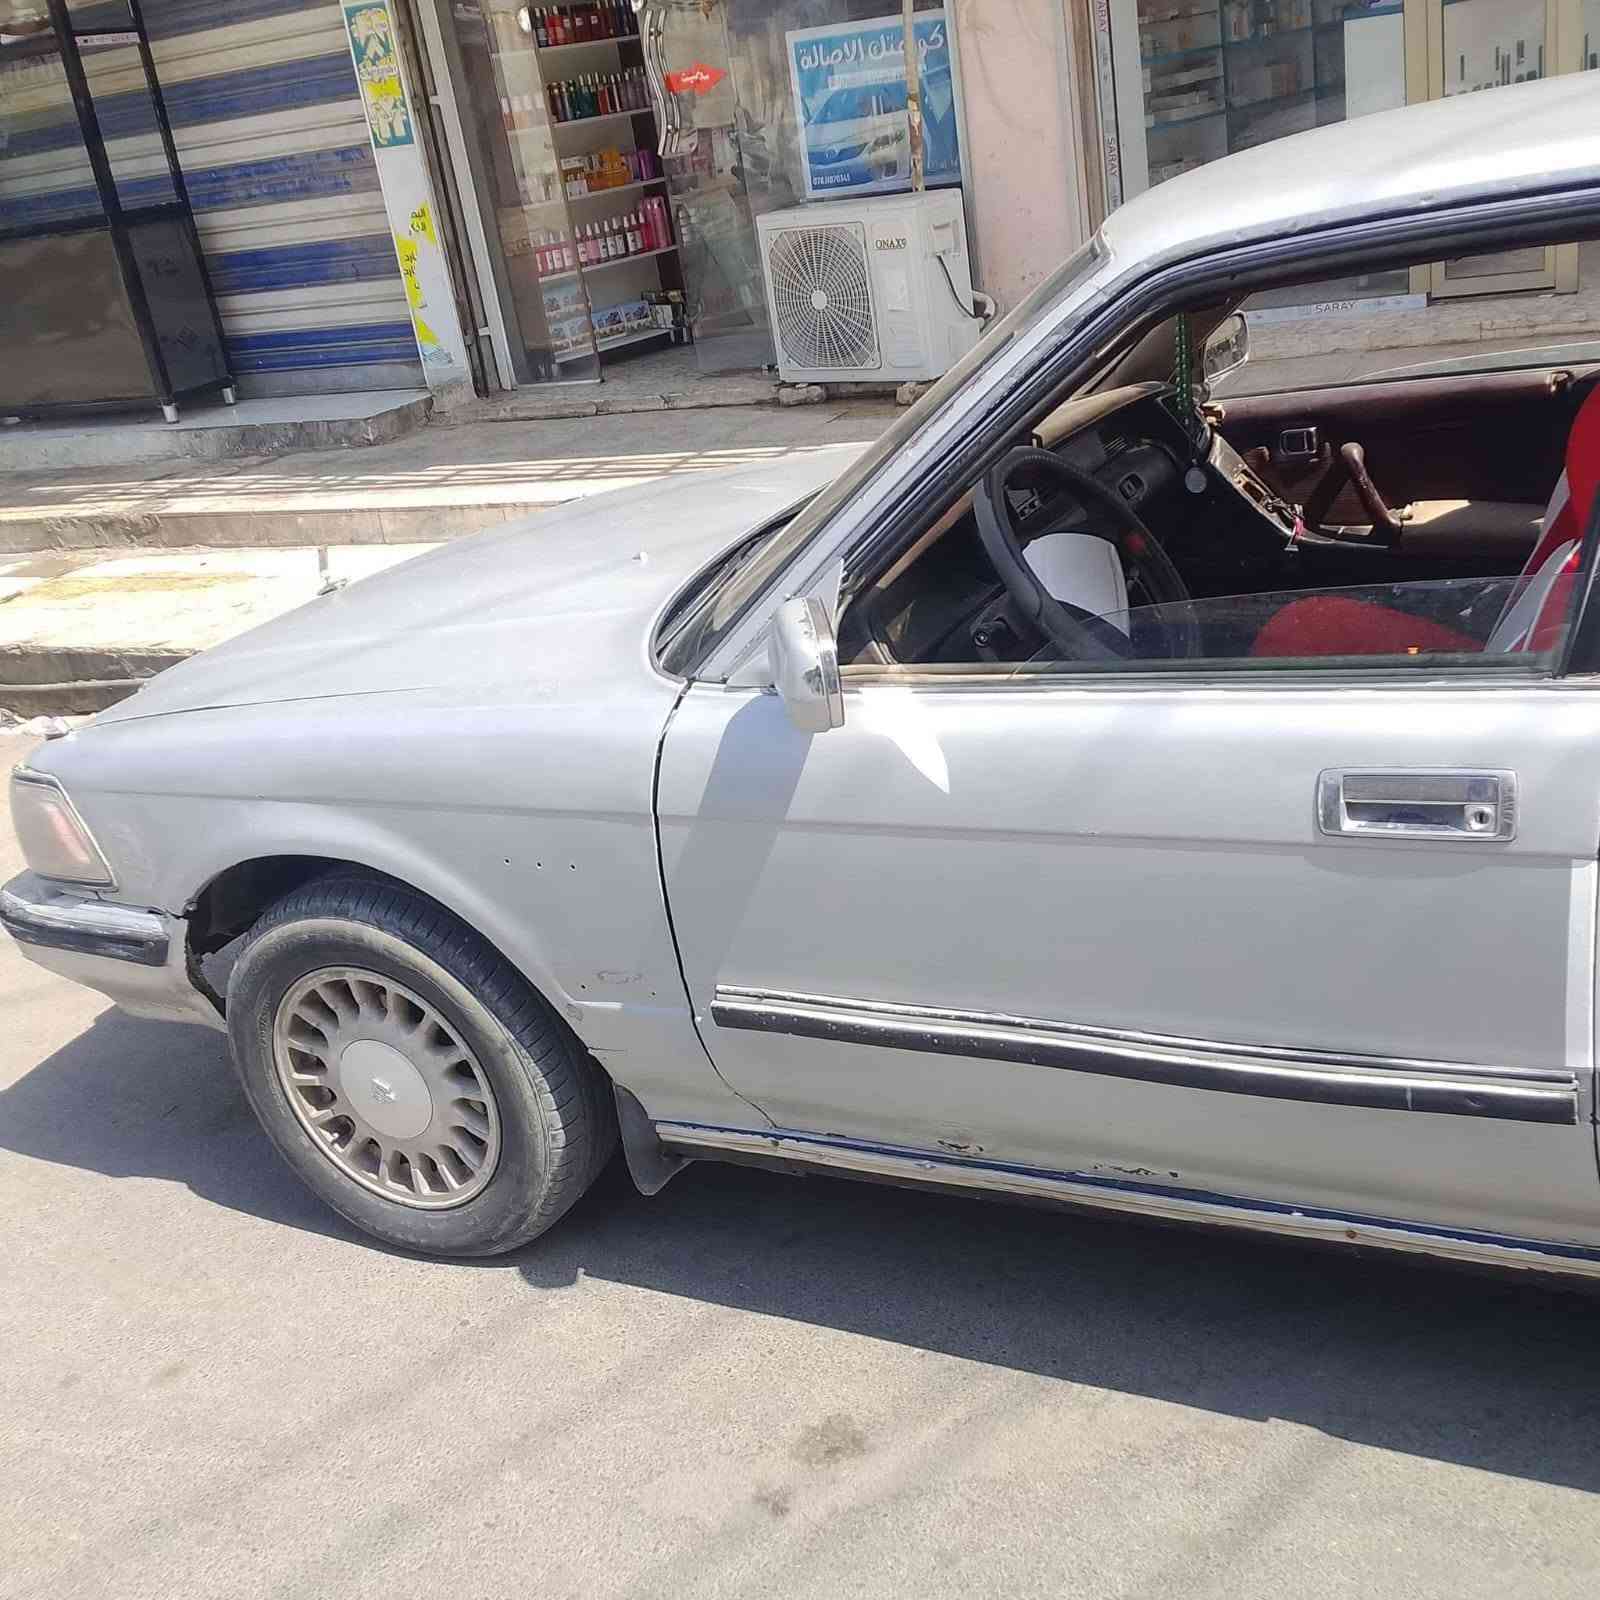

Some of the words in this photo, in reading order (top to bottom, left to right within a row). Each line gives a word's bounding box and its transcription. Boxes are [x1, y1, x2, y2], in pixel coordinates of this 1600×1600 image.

[1096, 0, 1108, 32] ARAY
[1106, 137, 1118, 176] SARAY
[1314, 302, 1356, 313] SARAY
